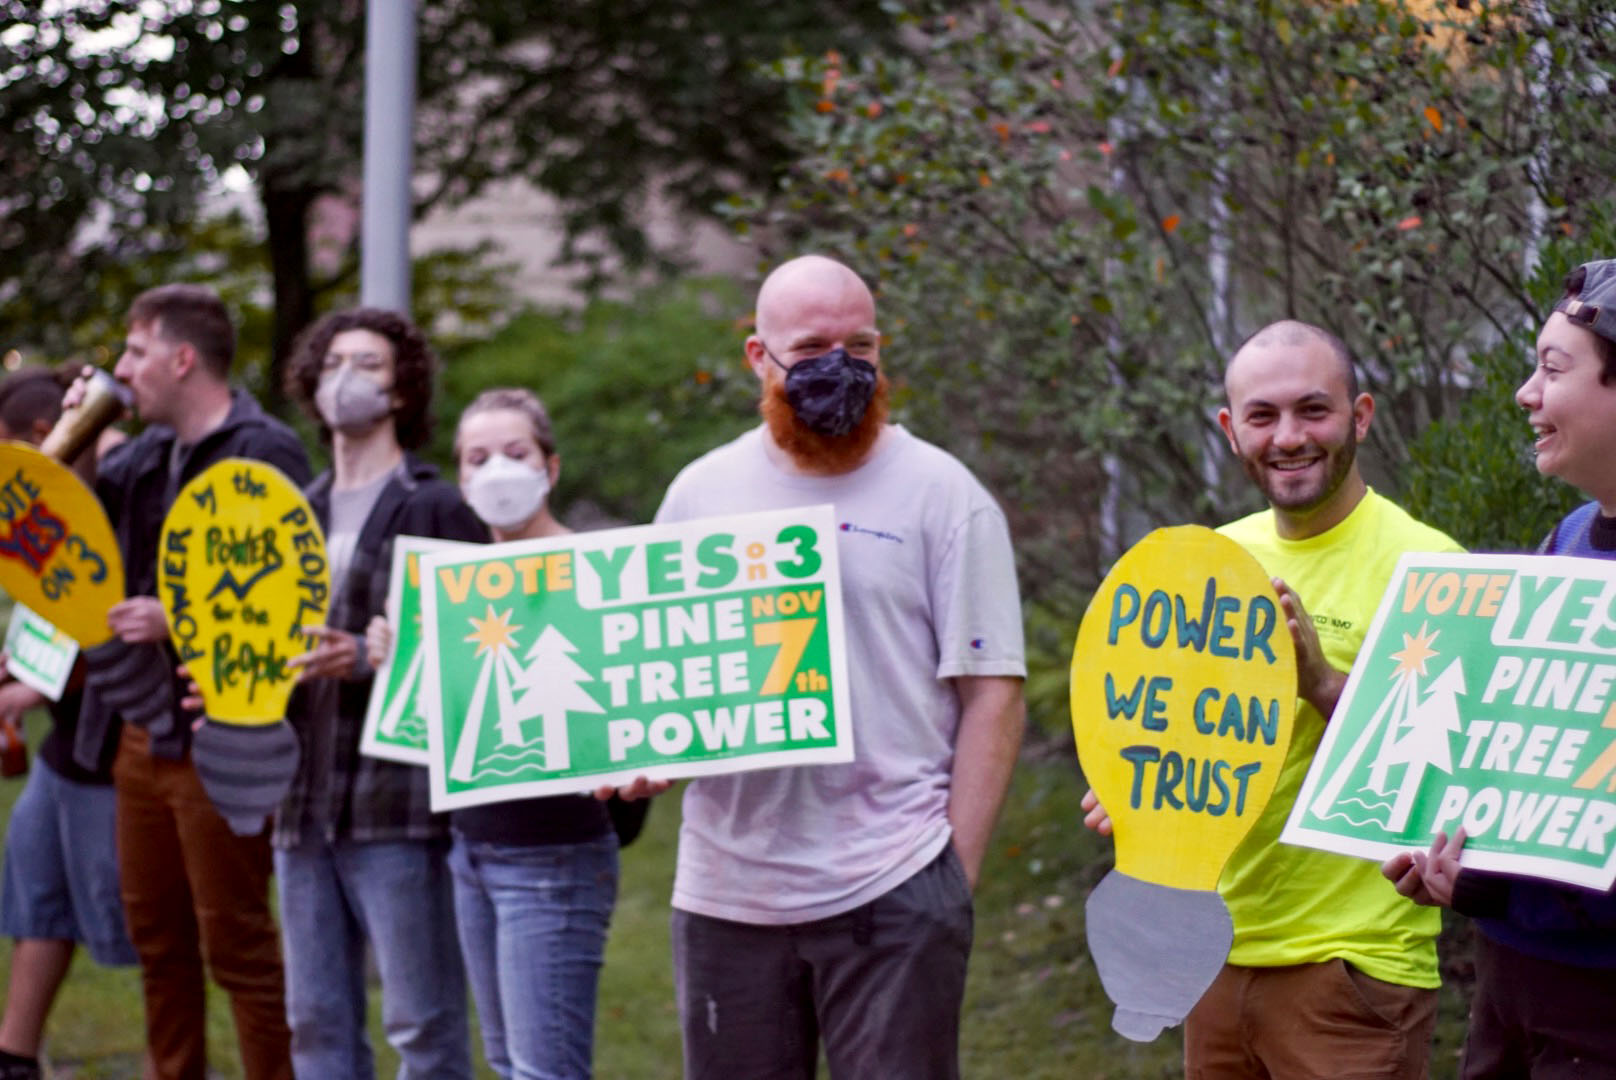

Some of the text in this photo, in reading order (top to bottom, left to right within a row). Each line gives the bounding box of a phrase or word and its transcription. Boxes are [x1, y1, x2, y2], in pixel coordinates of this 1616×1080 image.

[0, 468, 41, 521] OTE
[0, 503, 65, 572] YES
[66, 535, 108, 584] 3
[164, 528, 204, 661] POWER
[231, 468, 268, 499] the
[438, 553, 575, 604] VOTE
[582, 533, 740, 601] YES
[746, 541, 769, 581] on
[775, 525, 822, 579] 3
[751, 590, 823, 618] NOV
[1107, 577, 1277, 665] POWER
[1401, 571, 1512, 617] VOTE
[602, 598, 747, 655] PINE
[603, 651, 751, 707] TREE
[1104, 672, 1279, 746] WE CAN
[1481, 656, 1616, 714] PINE
[608, 697, 831, 762] POWER
[1458, 719, 1591, 779] TREE
[1119, 745, 1262, 817] TRUST
[1429, 785, 1616, 855] POWER
